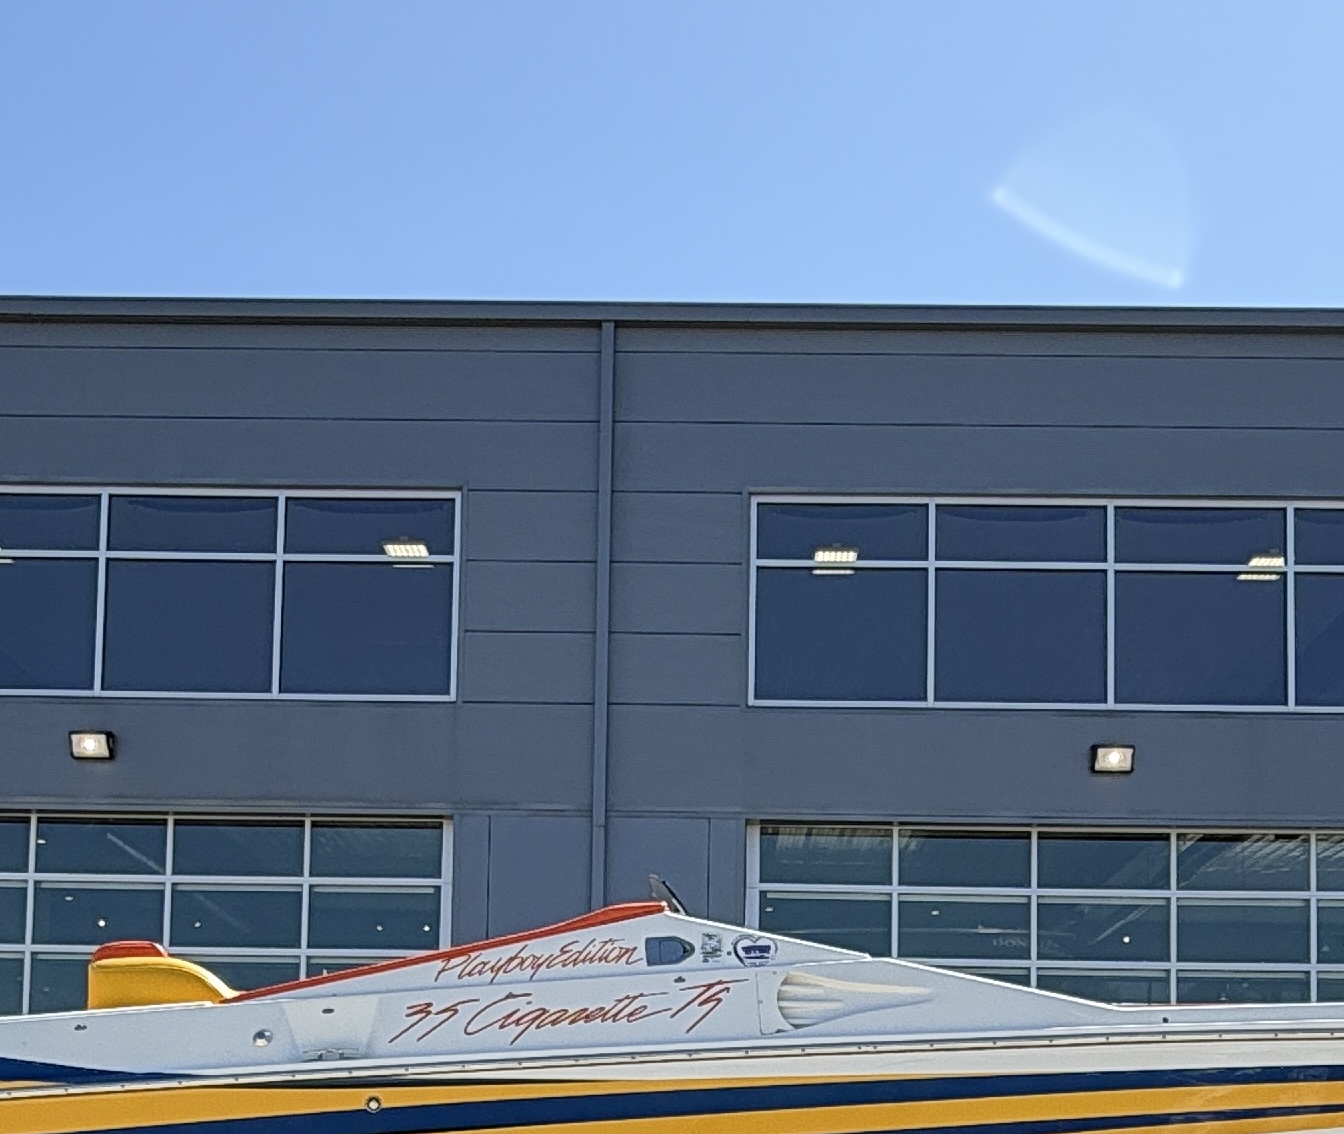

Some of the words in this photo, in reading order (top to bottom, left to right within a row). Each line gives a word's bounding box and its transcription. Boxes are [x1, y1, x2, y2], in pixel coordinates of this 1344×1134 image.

[434, 944, 552, 985] Playboy
[545, 937, 644, 970] Edition
[387, 998, 480, 1043] 35
[464, 991, 673, 1045] Cigarette
